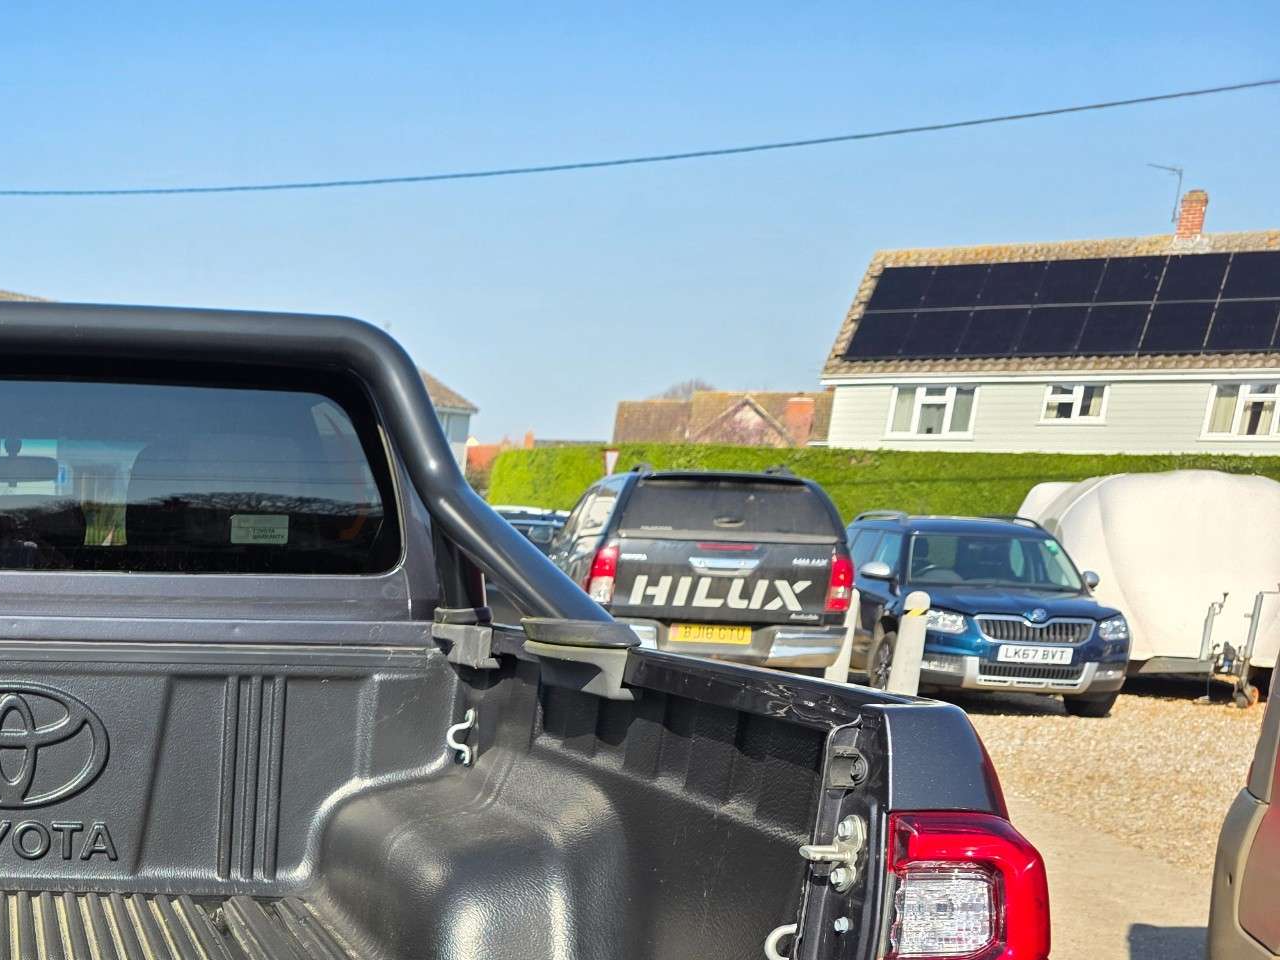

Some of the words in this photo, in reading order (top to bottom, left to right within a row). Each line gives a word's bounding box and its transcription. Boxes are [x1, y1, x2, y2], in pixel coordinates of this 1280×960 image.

[628, 574, 813, 611] HILUX
[1004, 647, 1039, 660] LK67
[1042, 649, 1066, 660] BVT
